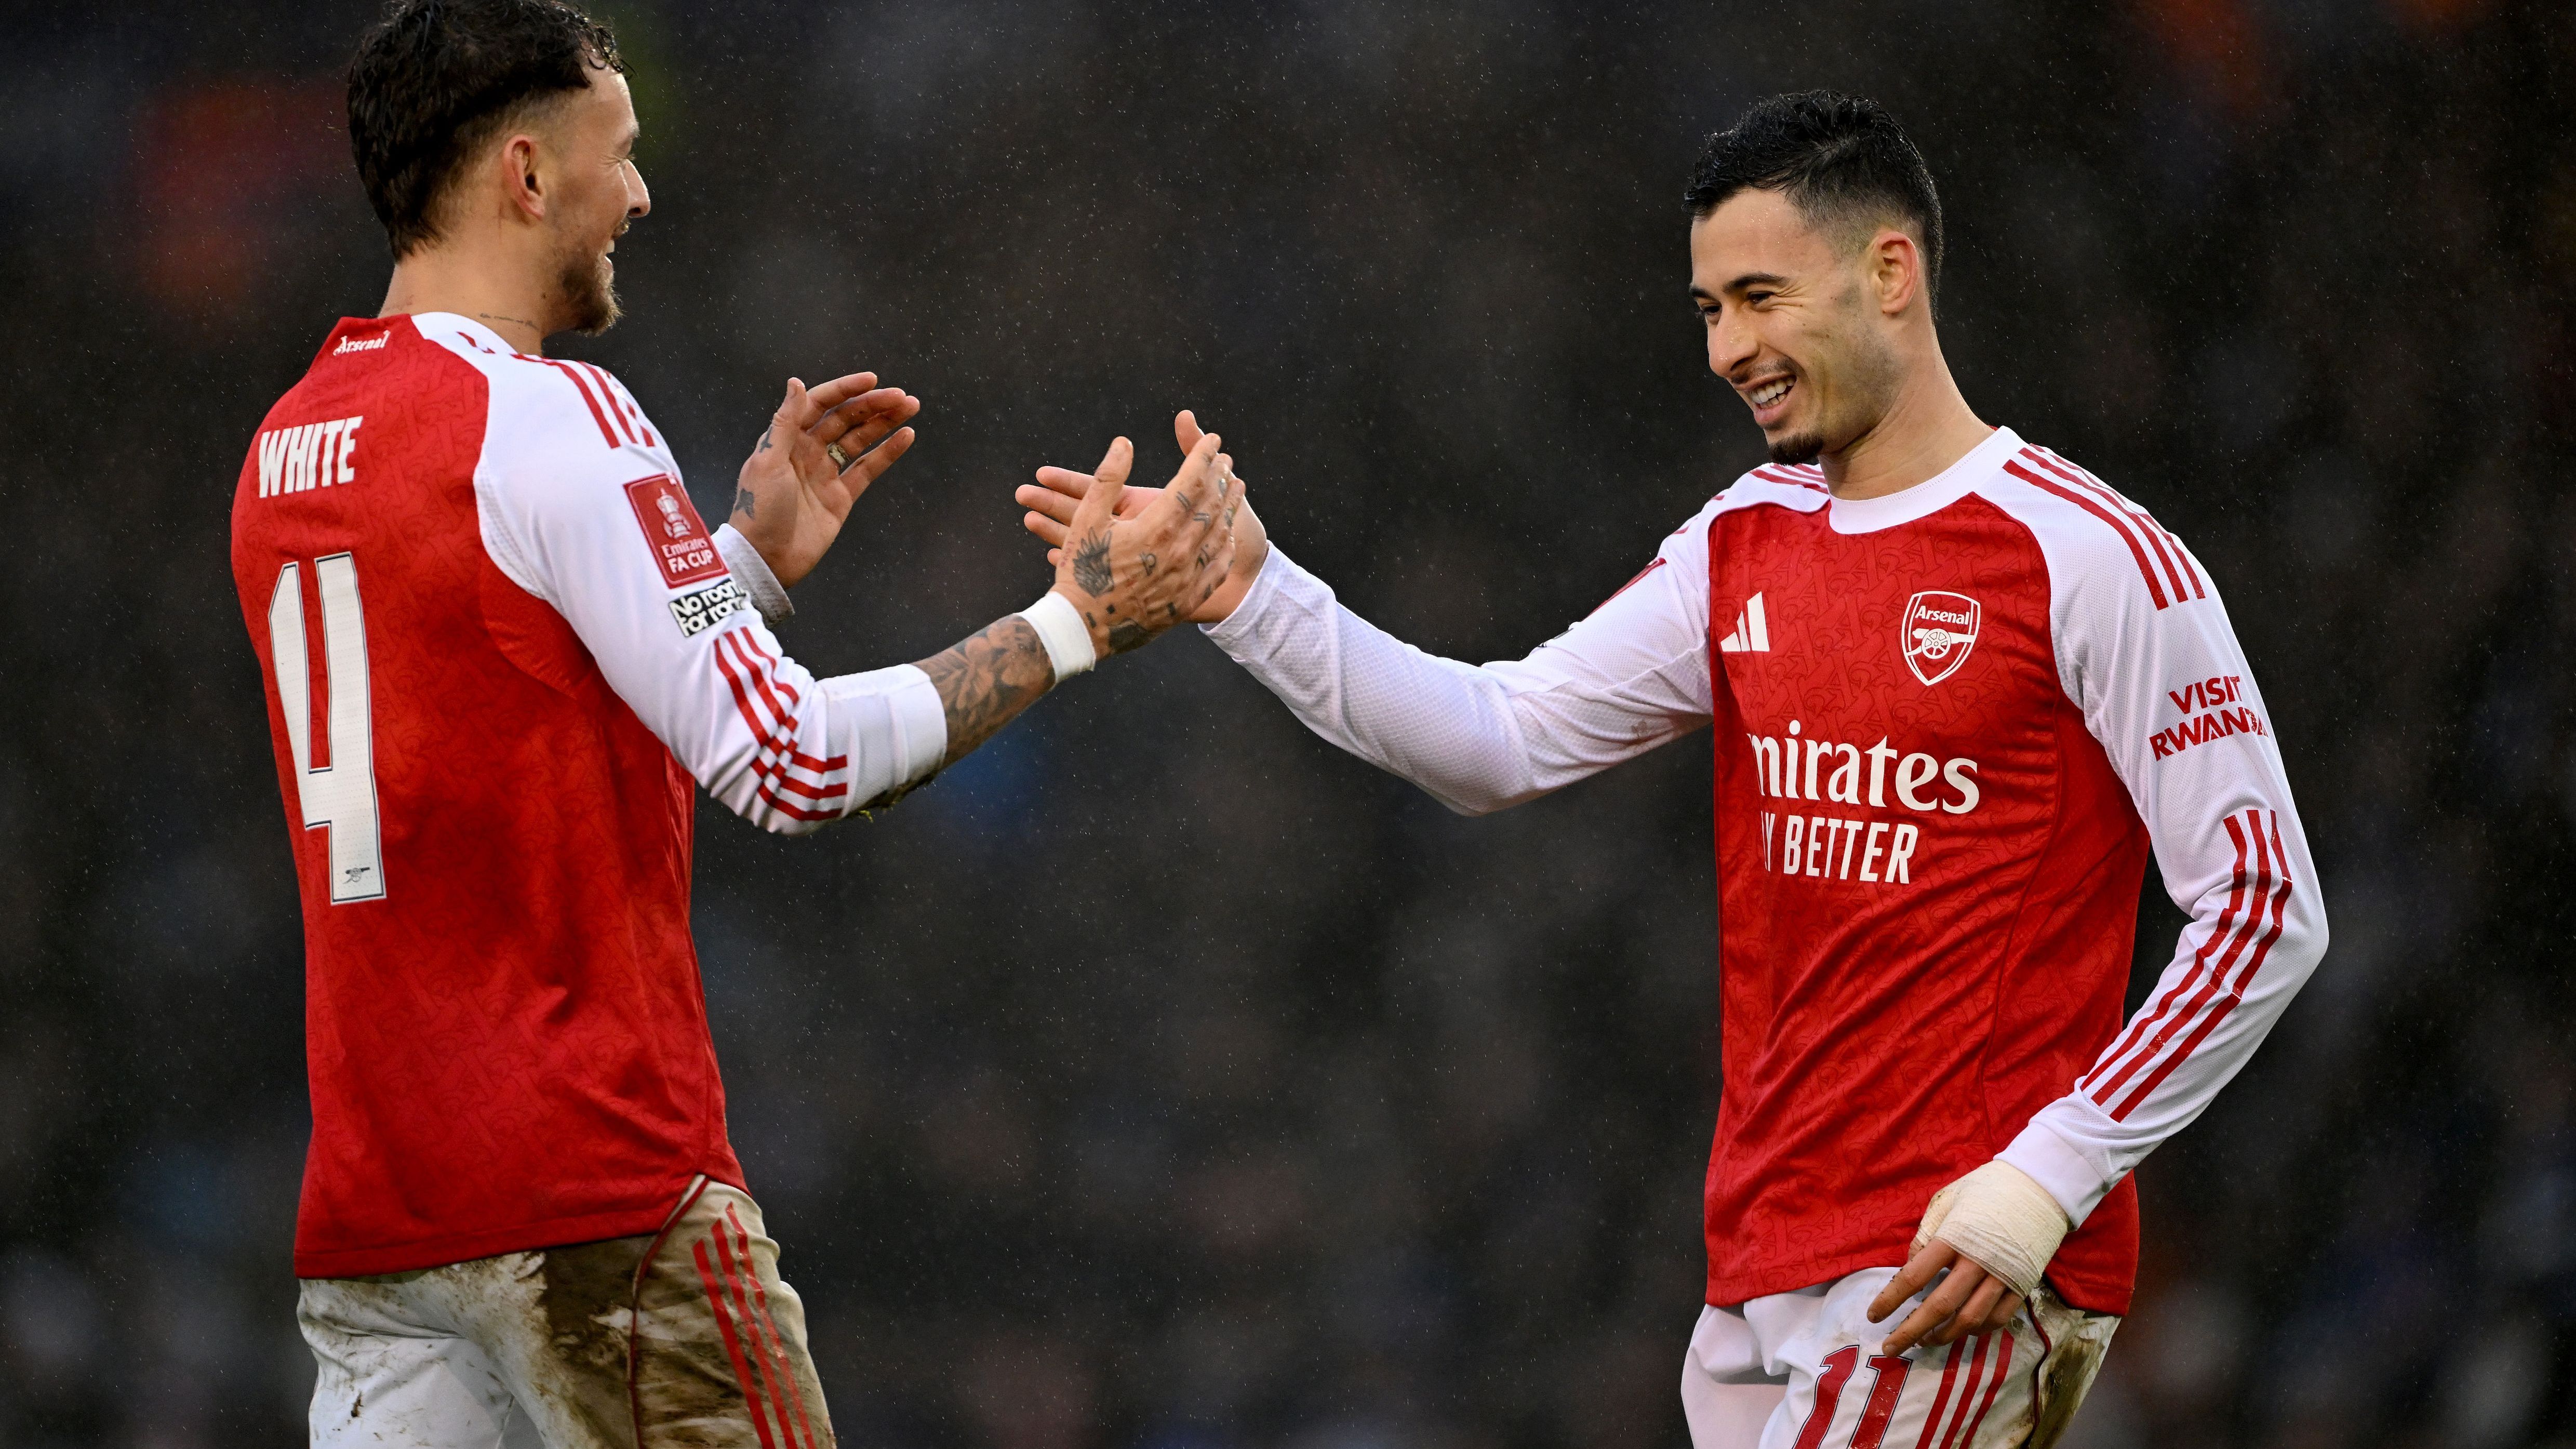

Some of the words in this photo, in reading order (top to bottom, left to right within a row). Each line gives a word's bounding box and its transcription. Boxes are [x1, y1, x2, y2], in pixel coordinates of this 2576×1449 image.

[333, 329, 391, 356] Arsenal
[259, 415, 363, 498] WHITE
[661, 538, 709, 559] Emirates
[668, 556, 690, 574] FA
[687, 549, 714, 568] CUP
[1915, 605, 1970, 625] Arsenal
[2168, 675, 2243, 714] VISIT
[268, 551, 386, 906] 4
[1746, 720, 1980, 814] mirates
[1783, 815, 1918, 884] BETTER
[1791, 1345, 1913, 1449] 11
